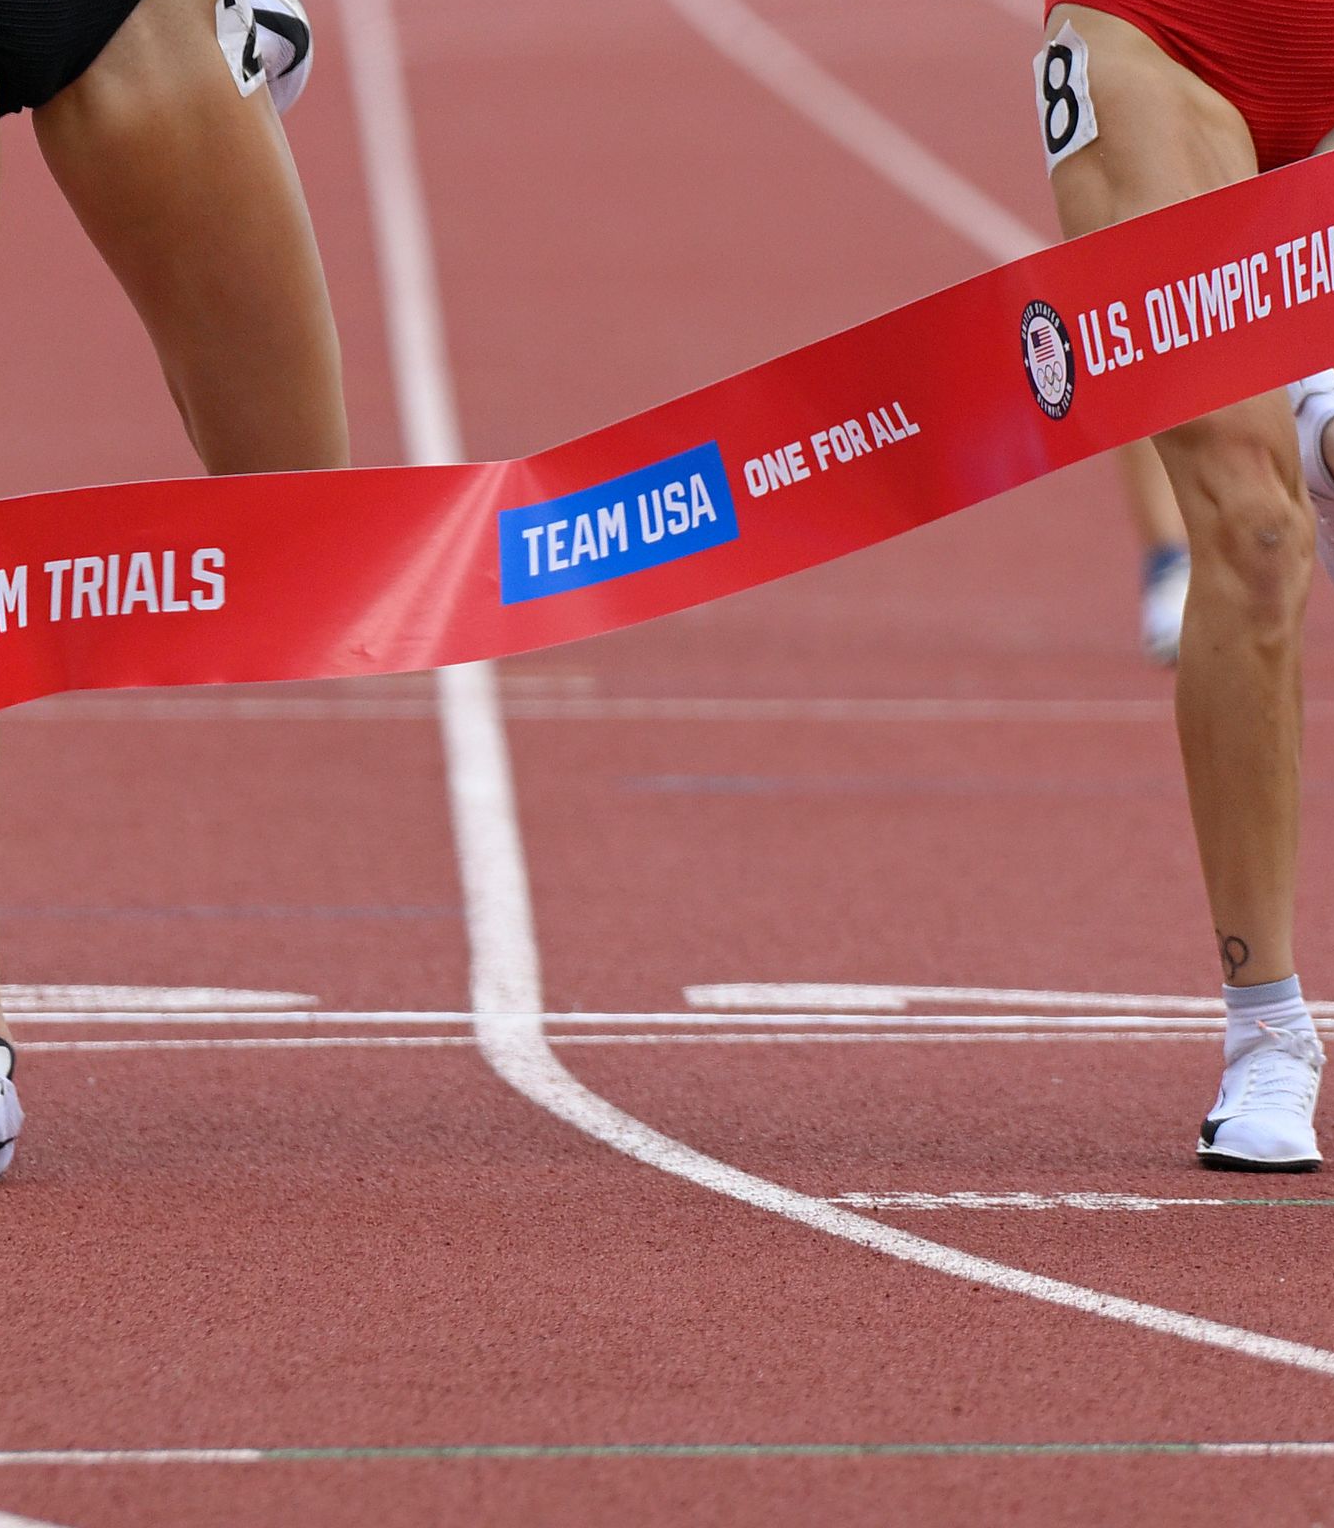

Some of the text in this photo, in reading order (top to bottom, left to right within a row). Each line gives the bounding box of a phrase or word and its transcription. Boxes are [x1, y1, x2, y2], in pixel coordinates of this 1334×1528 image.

[1043, 43, 1080, 155] 8
[1078, 300, 1144, 377] U.S.
[1144, 251, 1272, 356] OLYMPIC
[742, 400, 922, 499] ONE FOR ALL
[522, 472, 718, 577] TEAM USA
[42, 547, 227, 624] TRIALS
